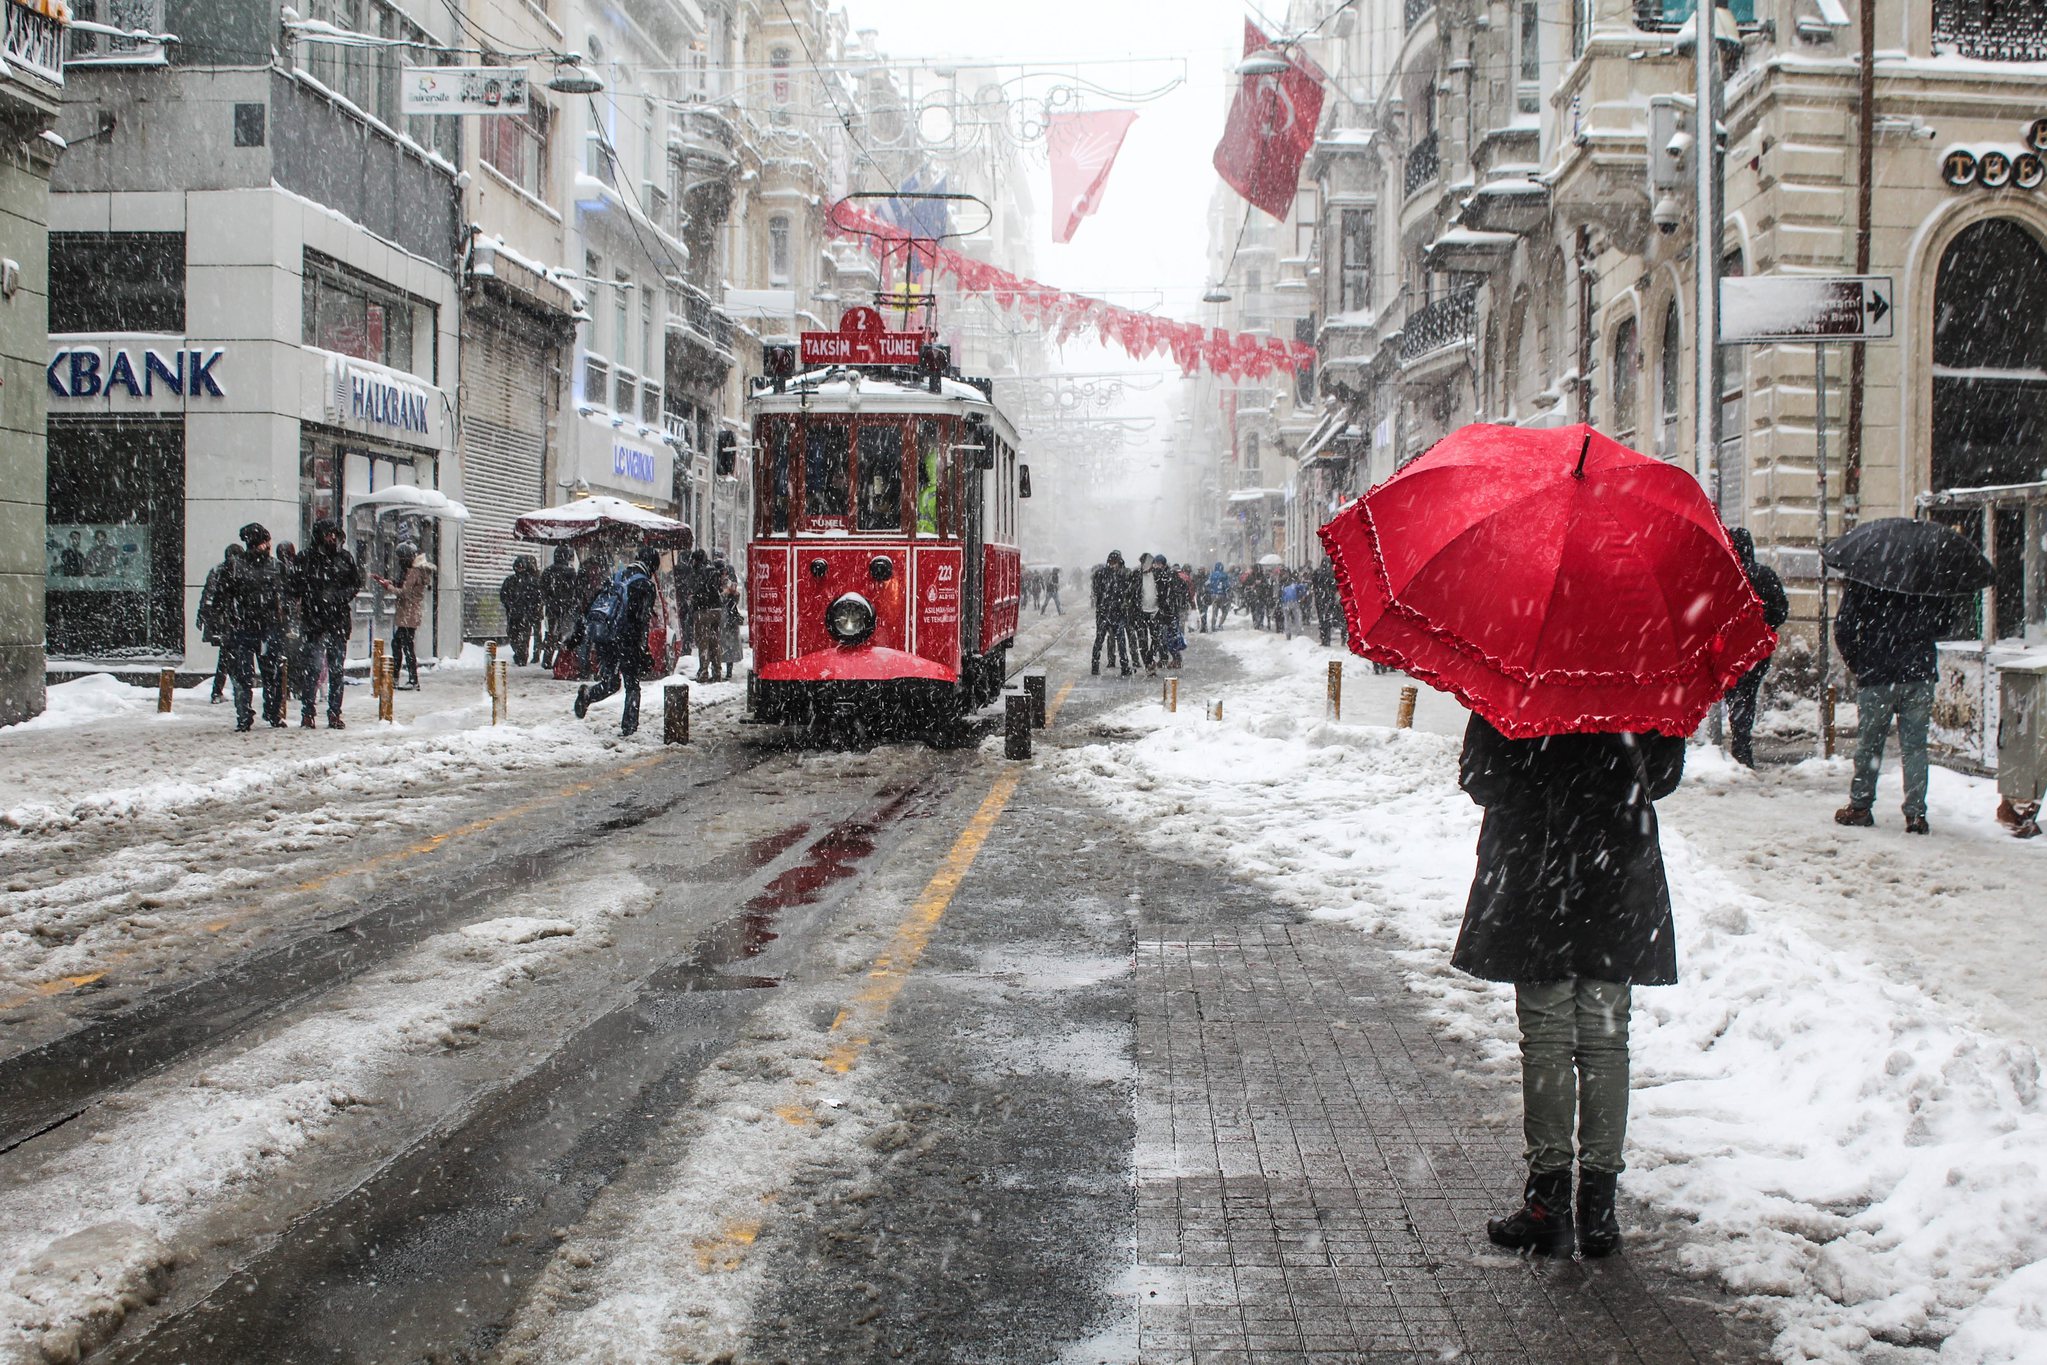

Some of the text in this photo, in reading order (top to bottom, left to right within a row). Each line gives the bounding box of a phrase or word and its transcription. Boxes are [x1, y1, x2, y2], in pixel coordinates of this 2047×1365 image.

[1945, 152, 2041, 185] THE
[857, 310, 866, 330] 2
[806, 336, 850, 356] TAKSİM
[880, 335, 919, 355] TÜNEL
[351, 375, 428, 434] HALKBANK
[938, 565, 953, 581] 223
